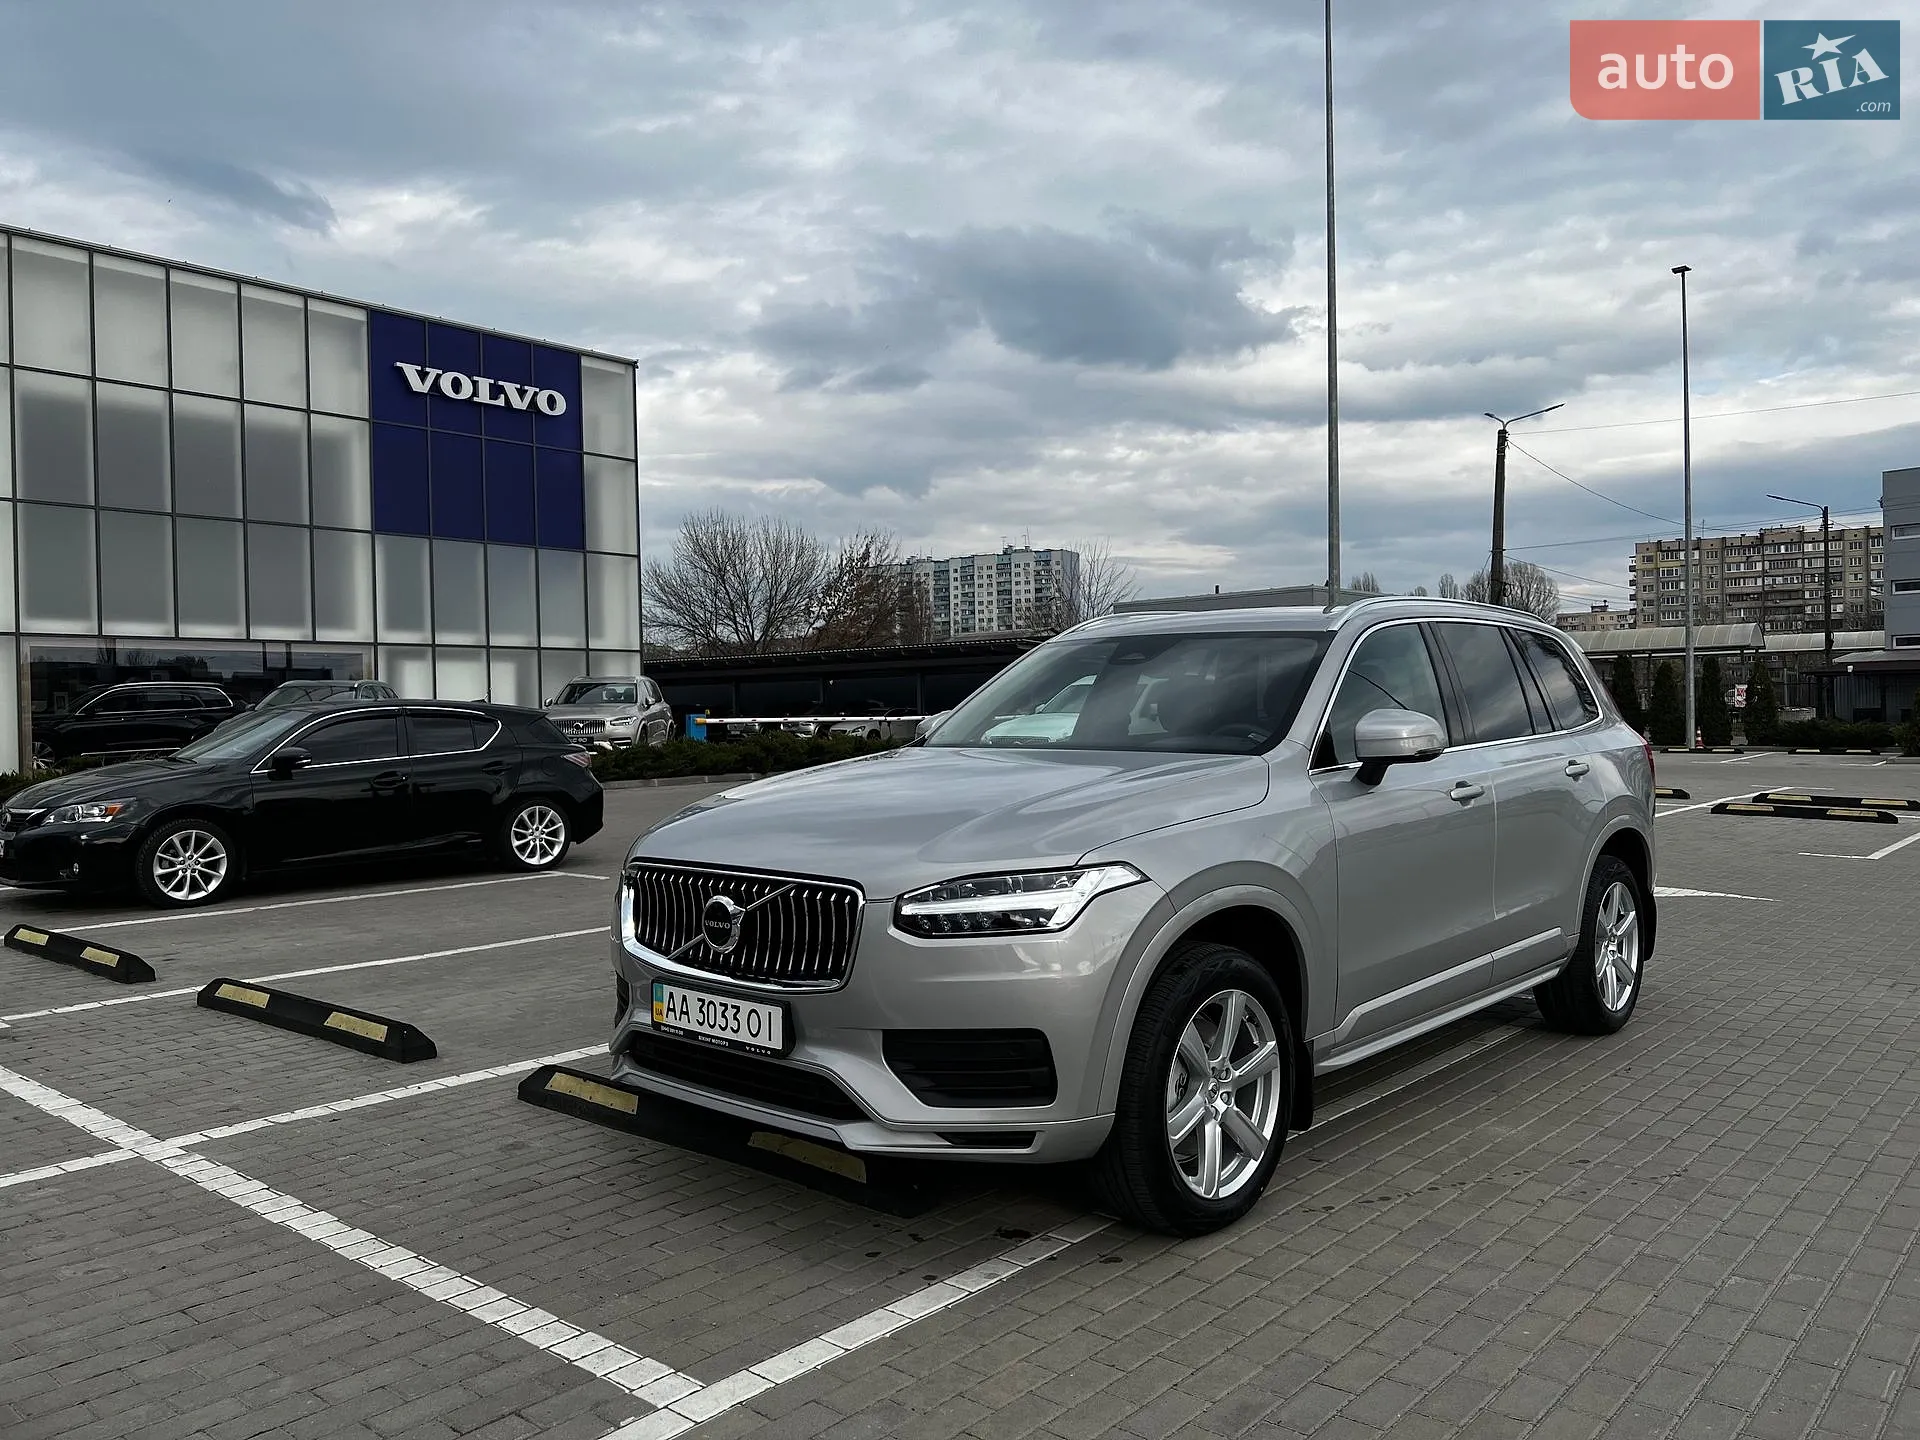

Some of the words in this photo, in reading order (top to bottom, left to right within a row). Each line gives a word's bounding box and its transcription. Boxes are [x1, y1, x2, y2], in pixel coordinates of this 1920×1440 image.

[394, 361, 567, 416] VOLVO
[705, 919, 731, 929] VOLVO
[655, 1007, 663, 1017] UA
[665, 991, 691, 1024] AA
[695, 997, 741, 1034] 3033
[745, 1046, 771, 1055] VOLVO
